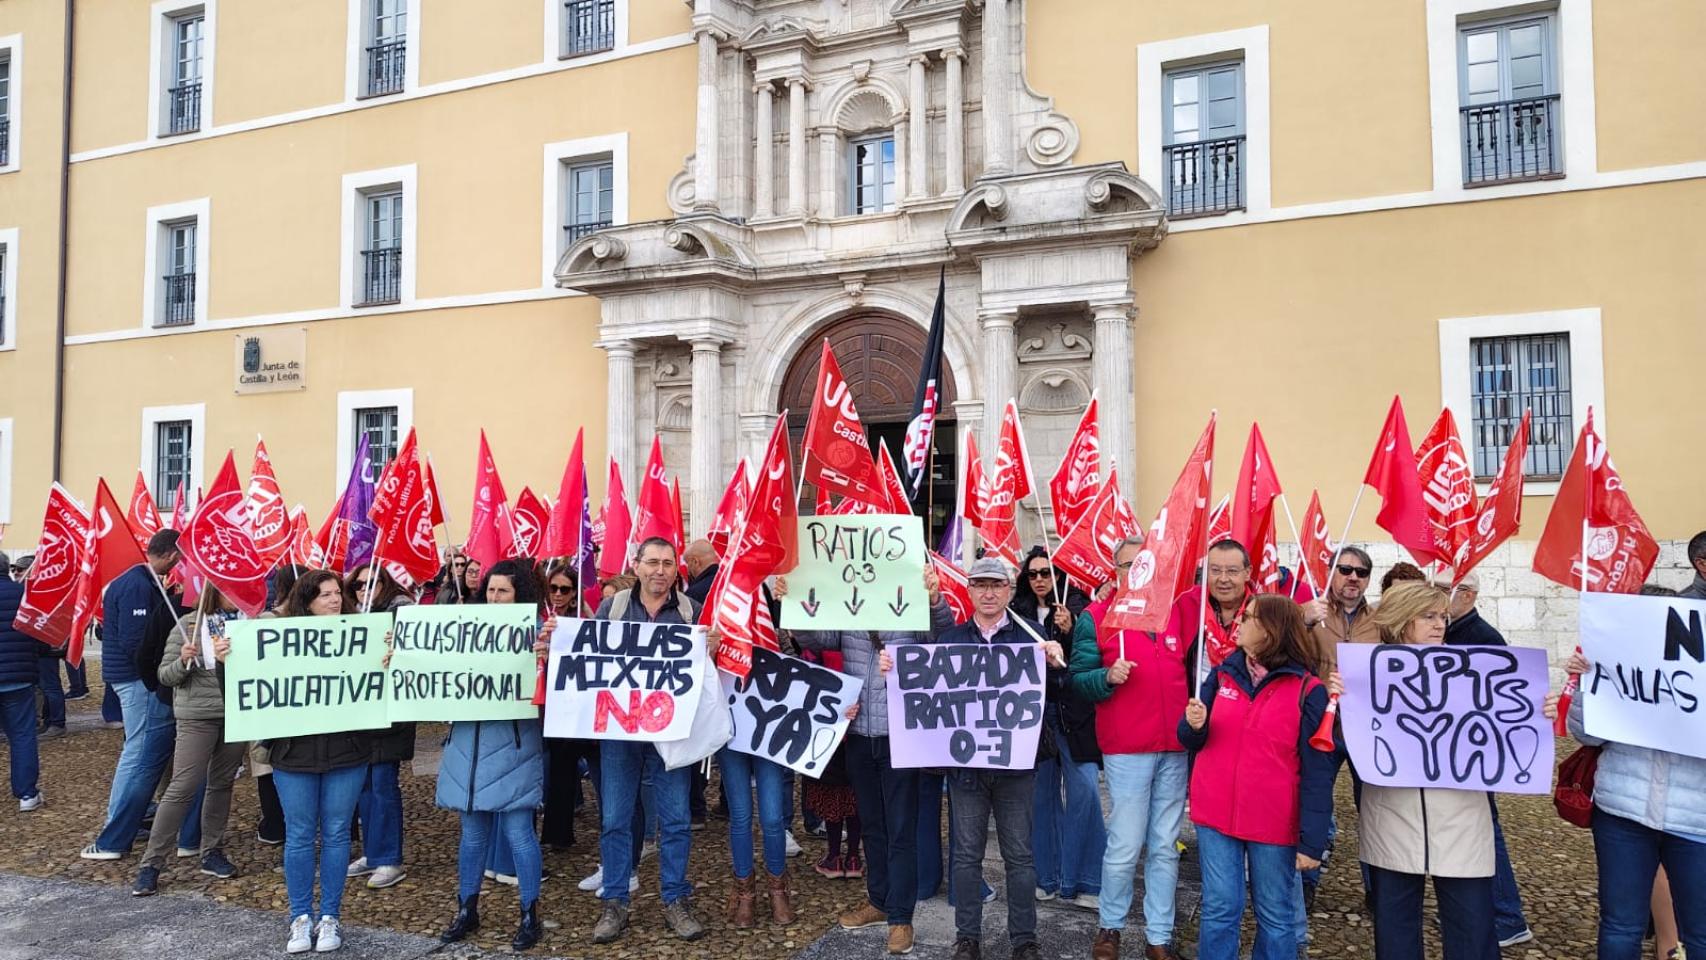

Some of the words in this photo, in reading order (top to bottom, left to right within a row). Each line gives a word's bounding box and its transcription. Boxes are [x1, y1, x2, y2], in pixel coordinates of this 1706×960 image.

[239, 373, 268, 384] Castilla
[269, 374, 275, 383] y
[276, 371, 300, 381] León
[261, 361, 285, 371] Junta
[287, 359, 300, 369] de
[823, 372, 860, 421] UG
[807, 521, 907, 563] RATIOS
[842, 563, 877, 584] 0-3
[571, 620, 693, 657] AULAS
[554, 655, 694, 696] MIXTAS
[896, 645, 1042, 690] BAJADA
[1590, 661, 1698, 714] AULAS
[592, 690, 675, 734] NO
[903, 690, 1042, 730] RATIOS
[949, 729, 1013, 768] 0-3
[1370, 711, 1540, 787] ¡YA!
